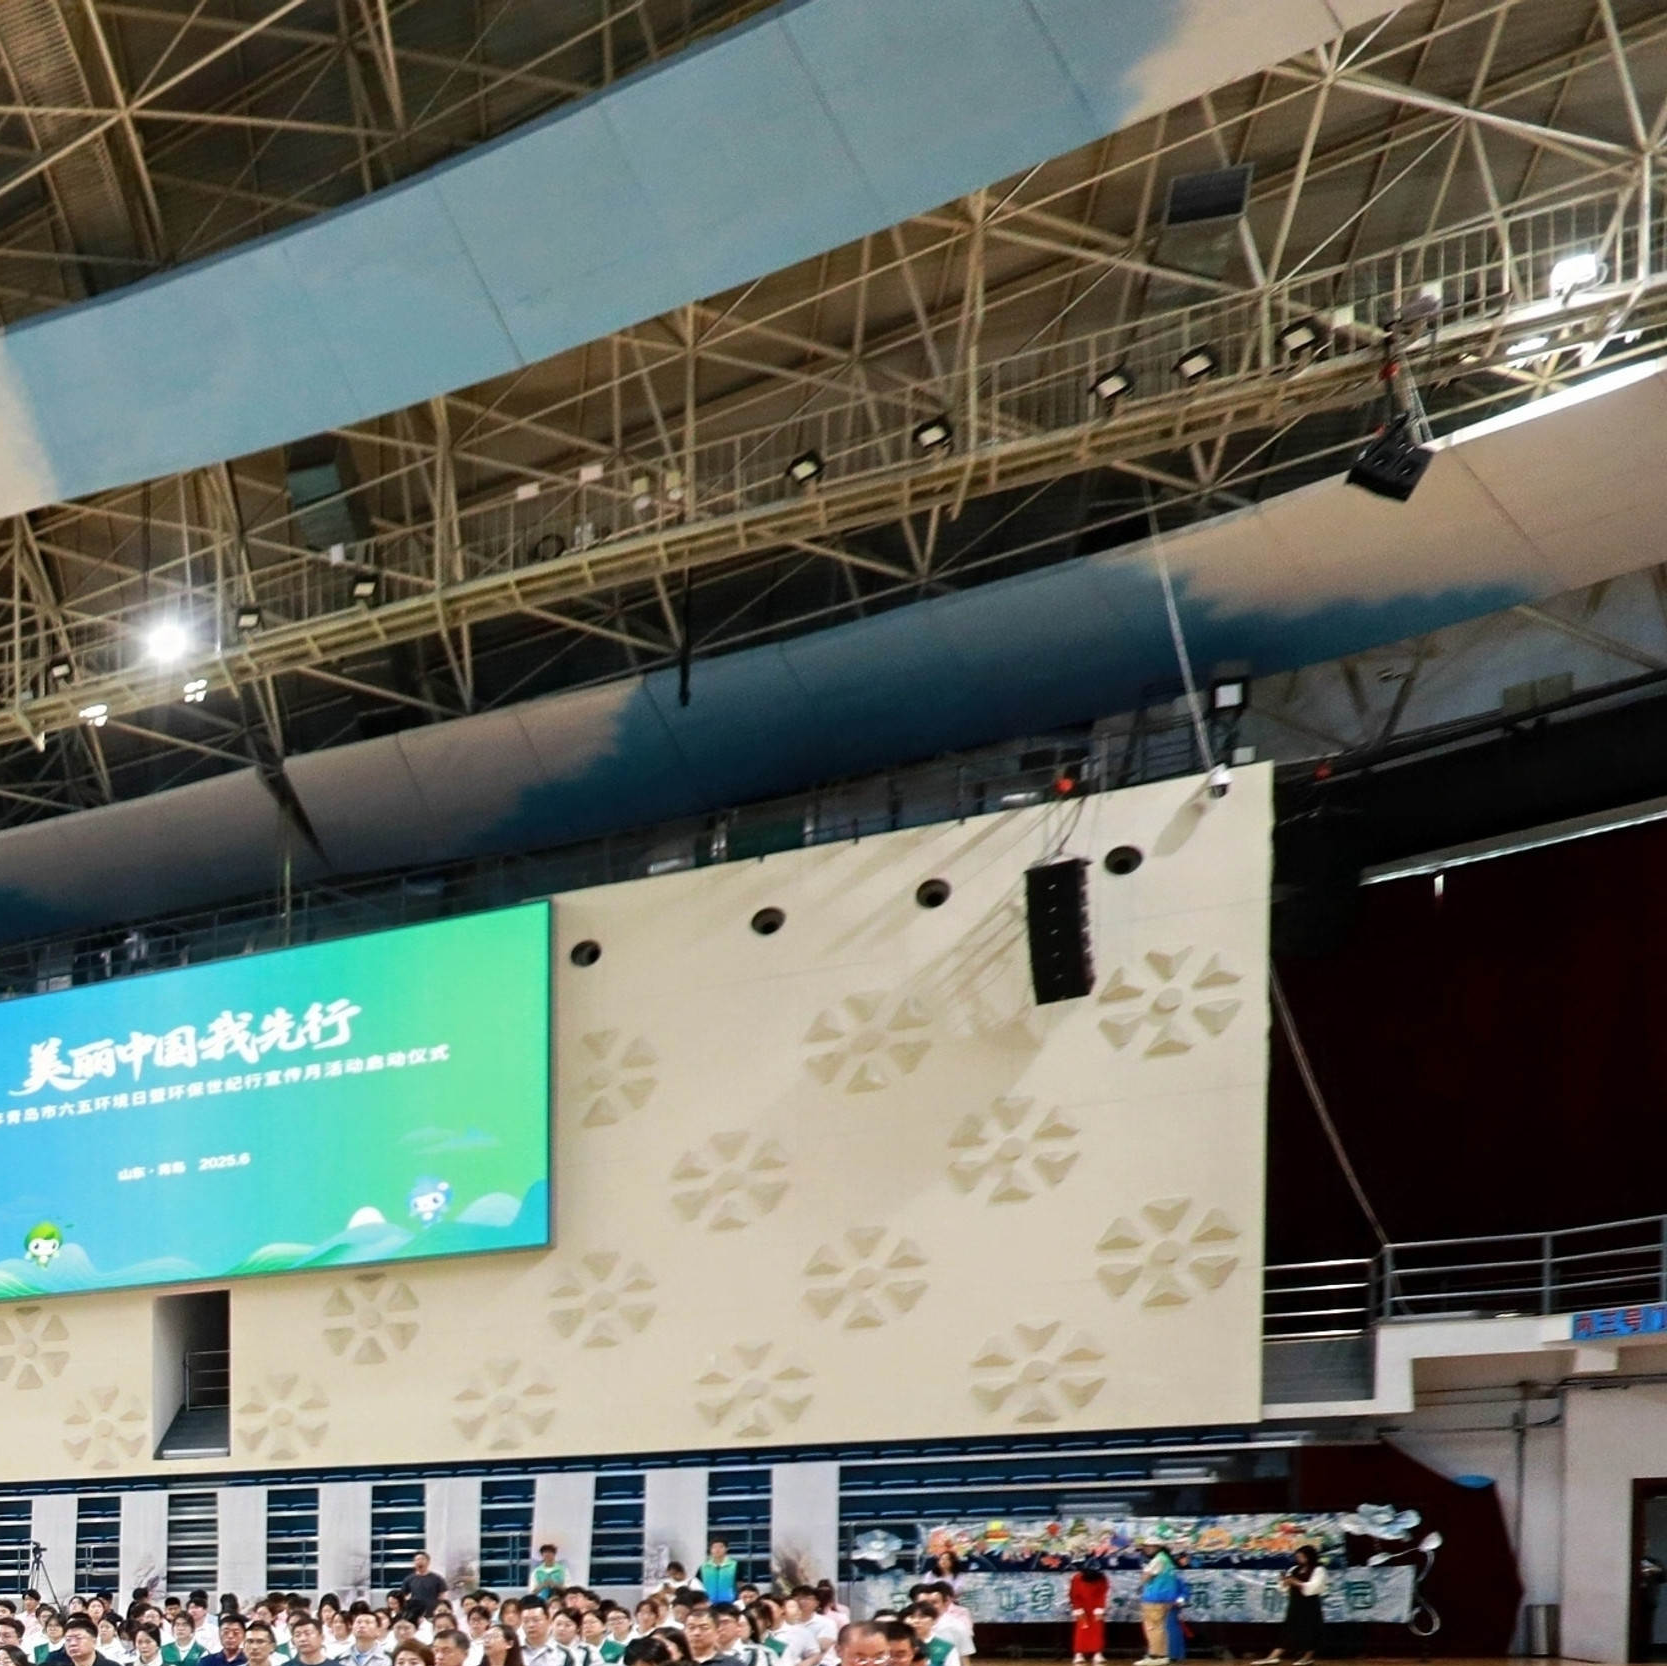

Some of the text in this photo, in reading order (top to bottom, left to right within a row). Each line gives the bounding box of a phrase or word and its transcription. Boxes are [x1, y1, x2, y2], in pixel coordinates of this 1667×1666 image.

[8, 998, 362, 1097] 美丽中国我先行
[198, 1152, 251, 1172] 2025.6
